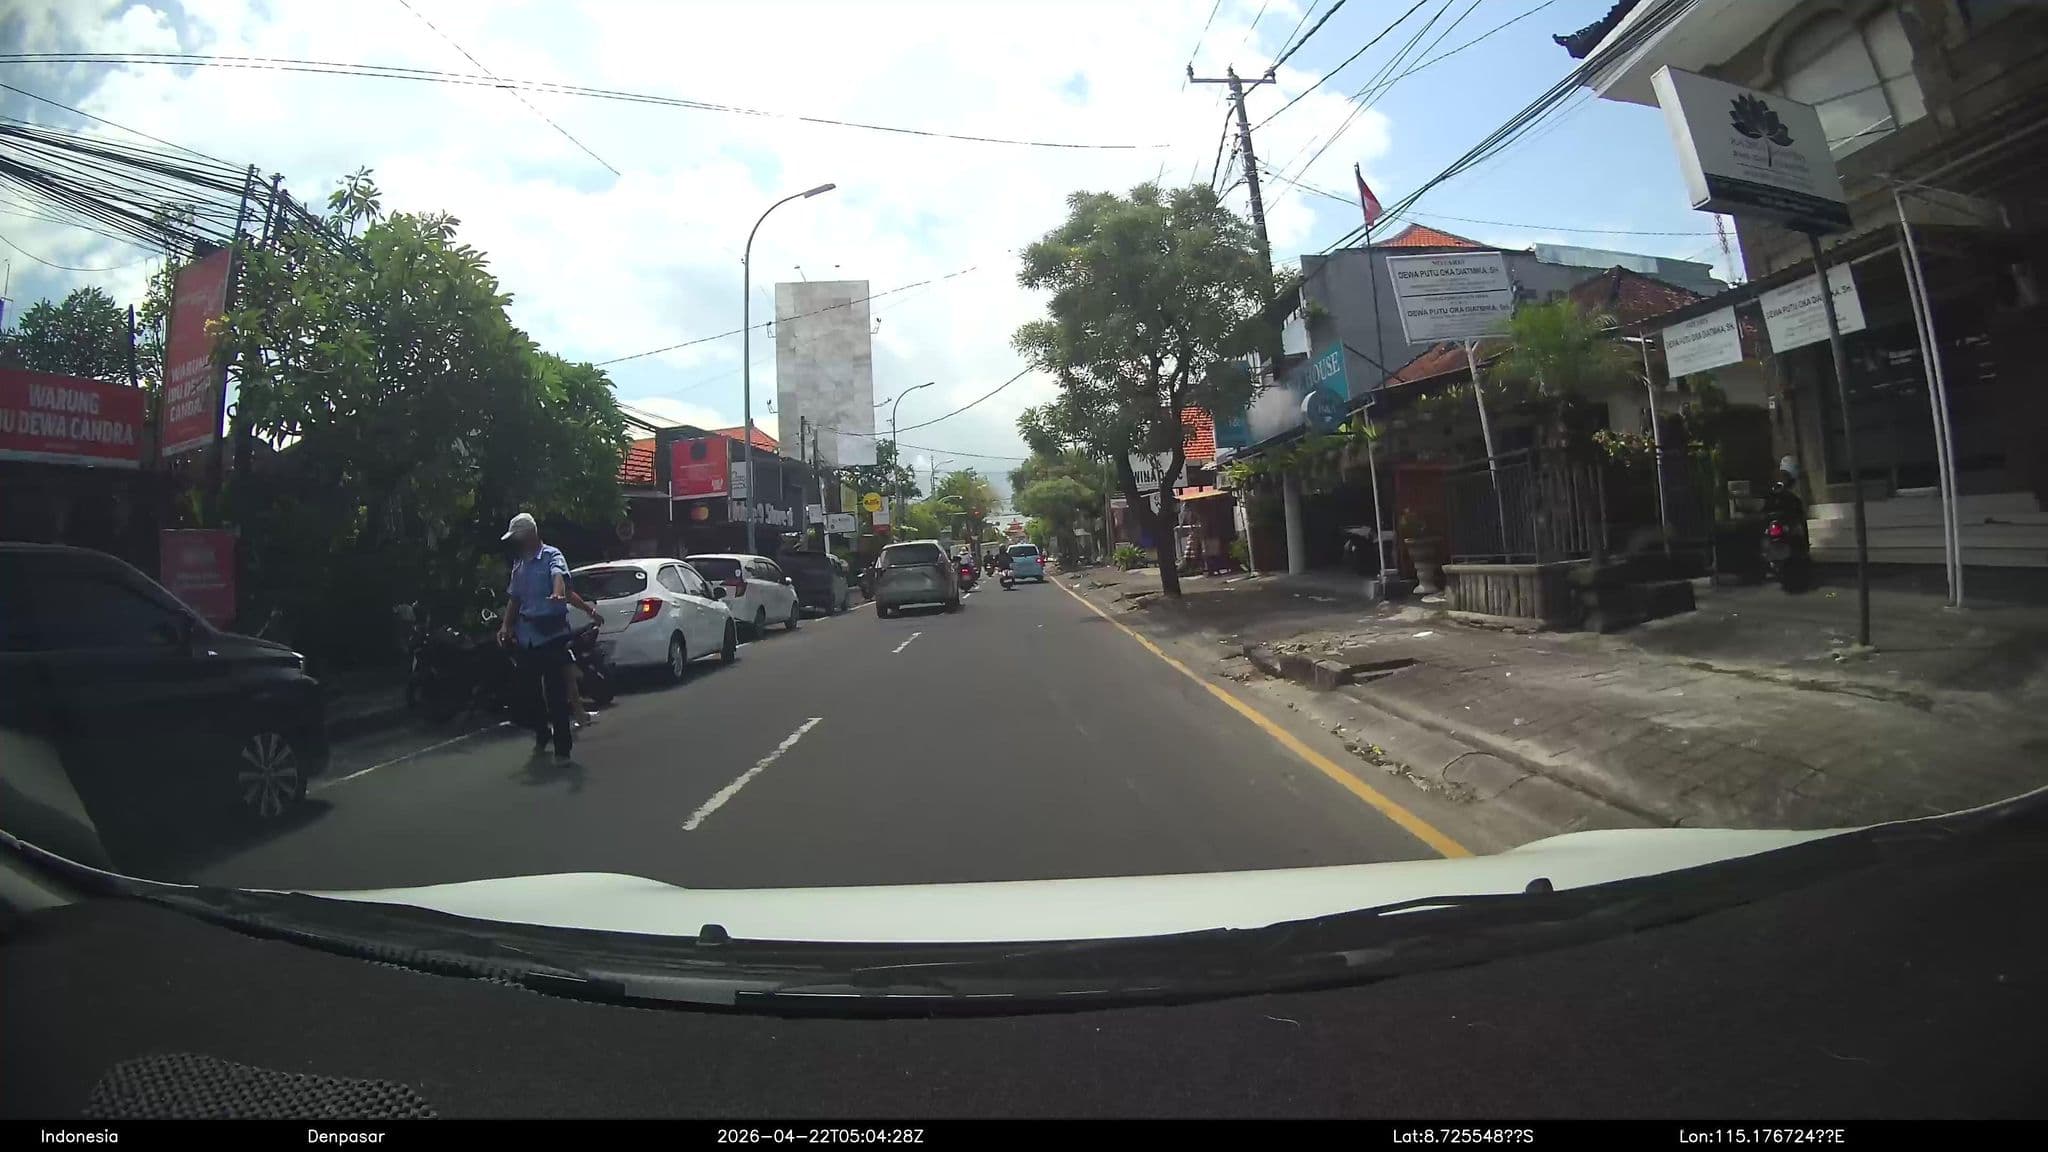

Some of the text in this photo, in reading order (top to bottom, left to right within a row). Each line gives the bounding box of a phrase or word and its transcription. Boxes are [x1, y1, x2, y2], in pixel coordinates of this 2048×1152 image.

[1398, 271, 1419, 280] DEWA
[1420, 269, 1440, 279] PUTU
[1408, 309, 1429, 318] DEWA
[1429, 308, 1448, 317] PUTU
[28, 384, 101, 415] WARUNG
[18, 409, 66, 439] DEWA
[71, 416, 136, 446] CANDRA
